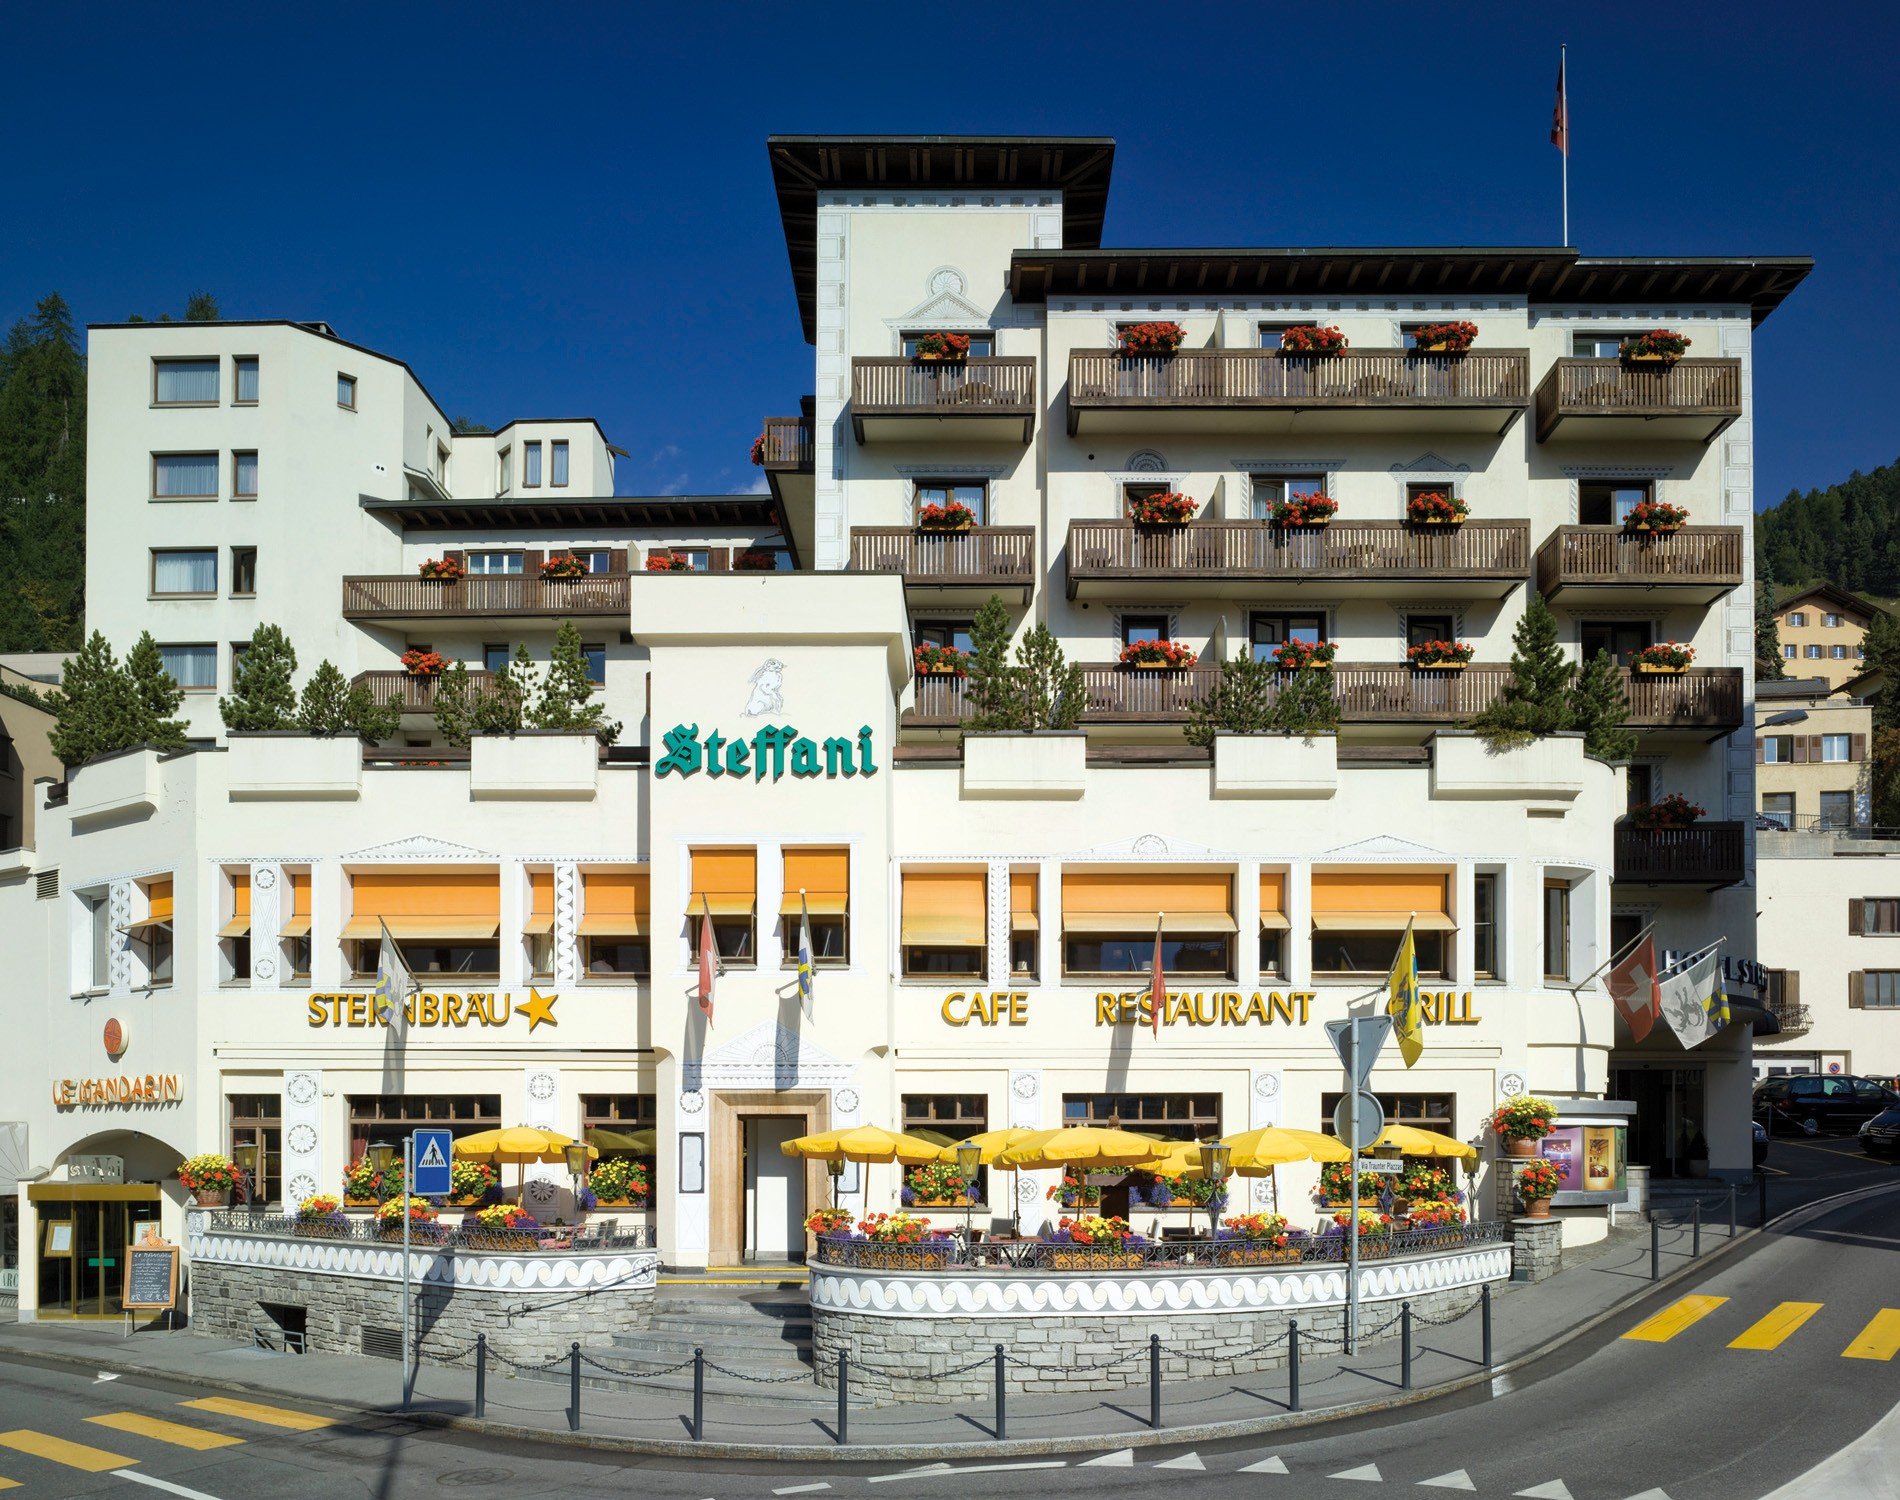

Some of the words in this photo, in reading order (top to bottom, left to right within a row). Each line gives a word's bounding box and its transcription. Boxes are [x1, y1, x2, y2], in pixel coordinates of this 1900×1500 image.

[655, 722, 879, 784] Steffani
[941, 991, 1029, 1026] CAFE
[1388, 991, 1483, 1024] RILL
[53, 1079, 78, 1105] LE
[80, 1074, 178, 1104] MANDARIN
